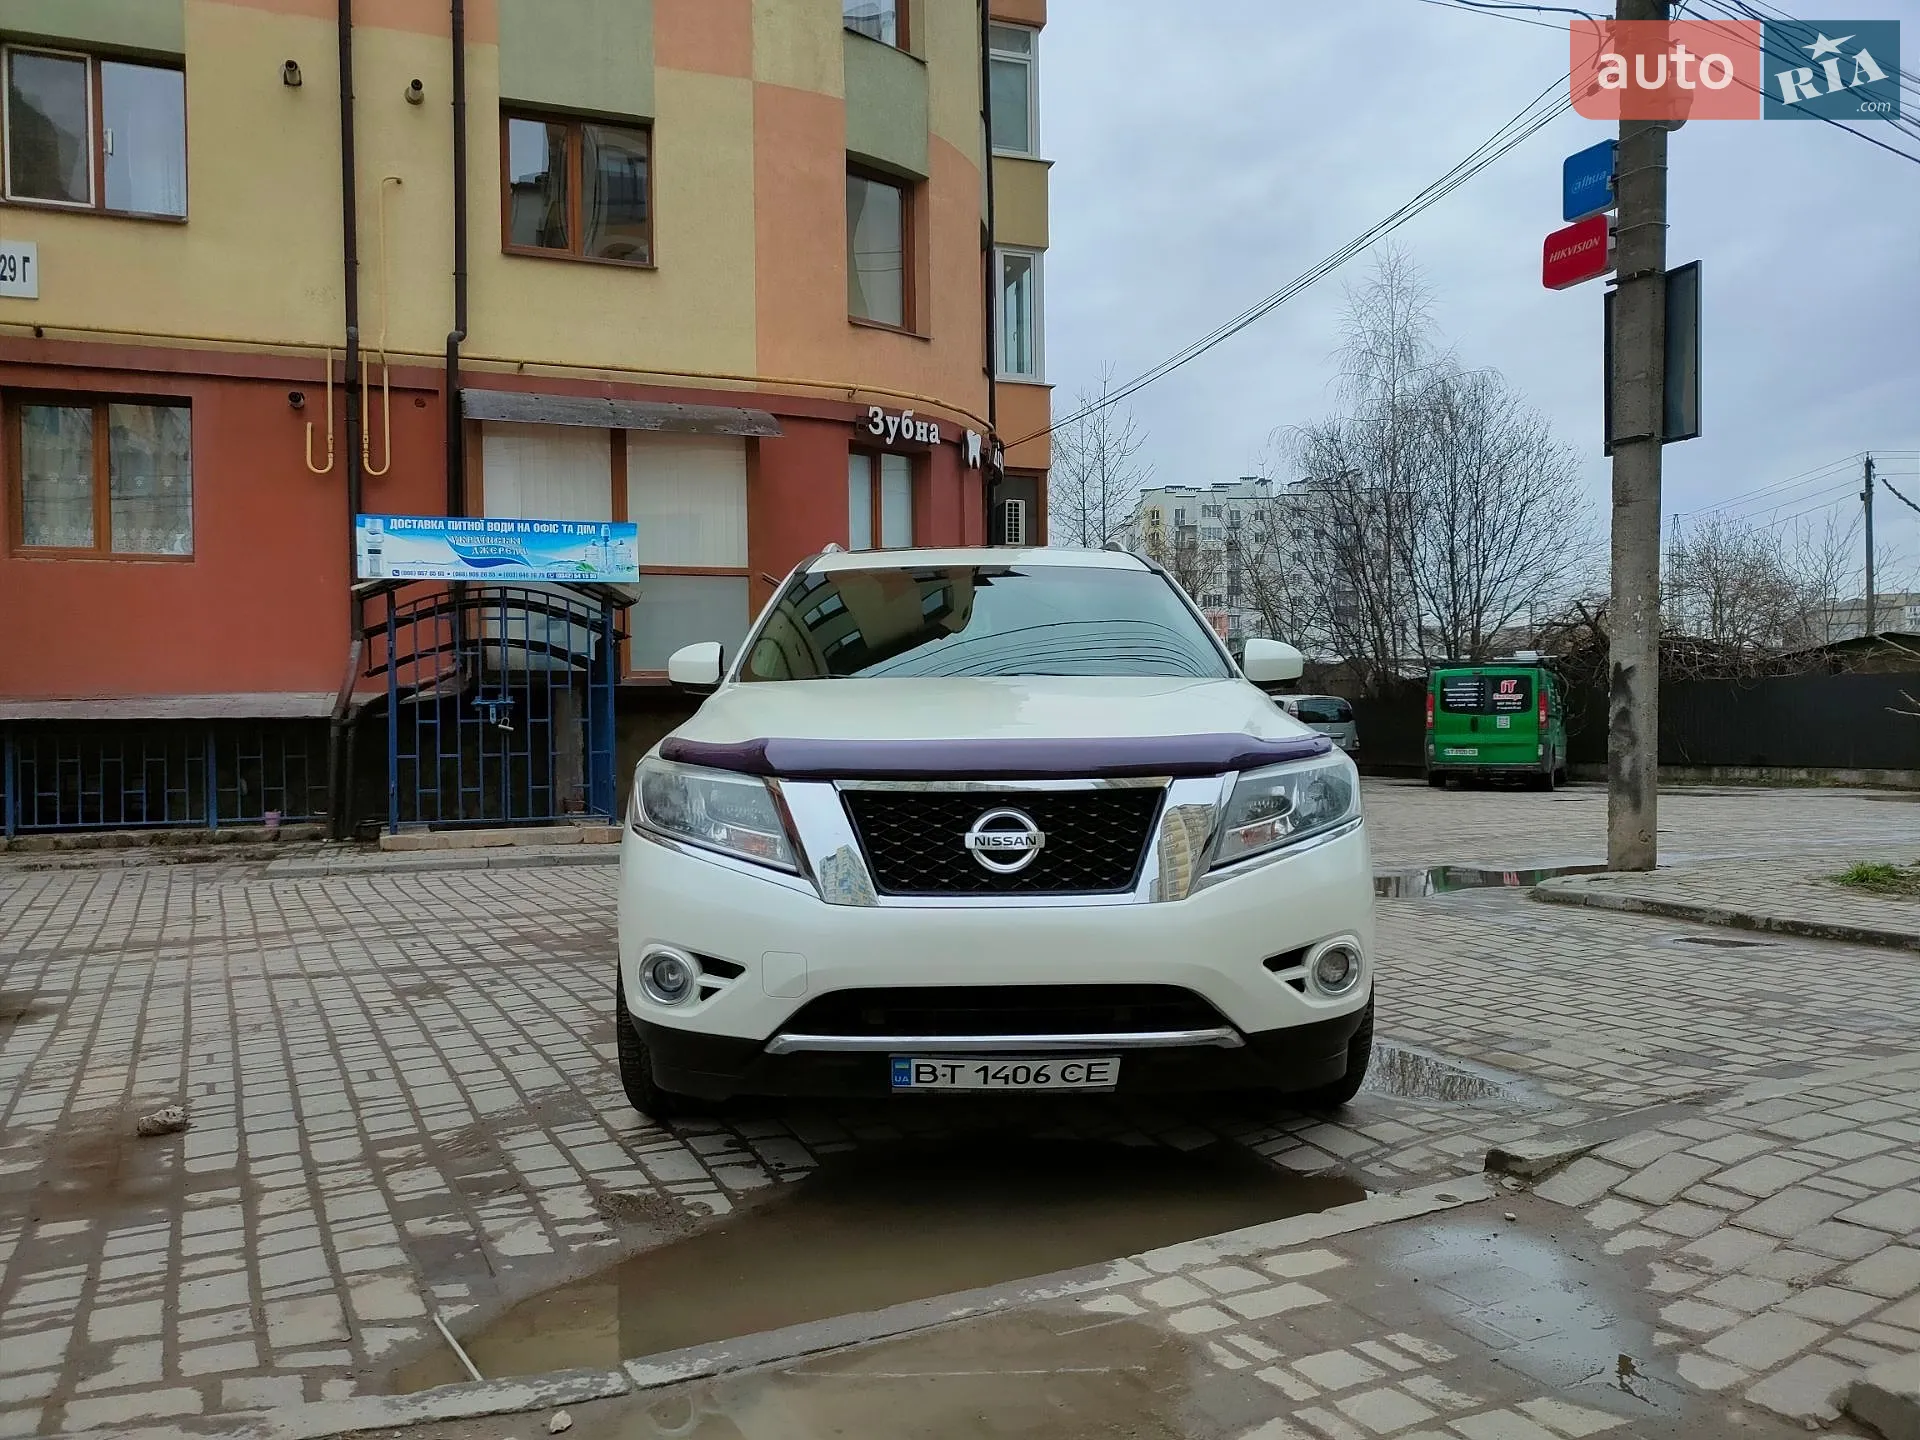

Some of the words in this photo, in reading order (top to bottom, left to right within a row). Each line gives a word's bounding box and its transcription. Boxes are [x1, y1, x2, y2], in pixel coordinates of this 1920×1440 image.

[1549, 235, 1601, 263] HIKVISION
[22, 255, 31, 283] Г
[868, 406, 940, 445] Зубна
[389, 518, 445, 530] ДОСТАВКА
[447, 519, 485, 532] ПИТНОЇ
[487, 520, 515, 533] ВОДИ
[517, 522, 531, 533] НА
[533, 523, 559, 534] ОФІС
[561, 523, 574, 534] ТА
[576, 524, 596, 536] ДІМ
[974, 836, 1036, 846] NISSAN
[915, 1063, 965, 1084] BT
[974, 1064, 1051, 1085] 1406
[1060, 1062, 1111, 1083] CE
